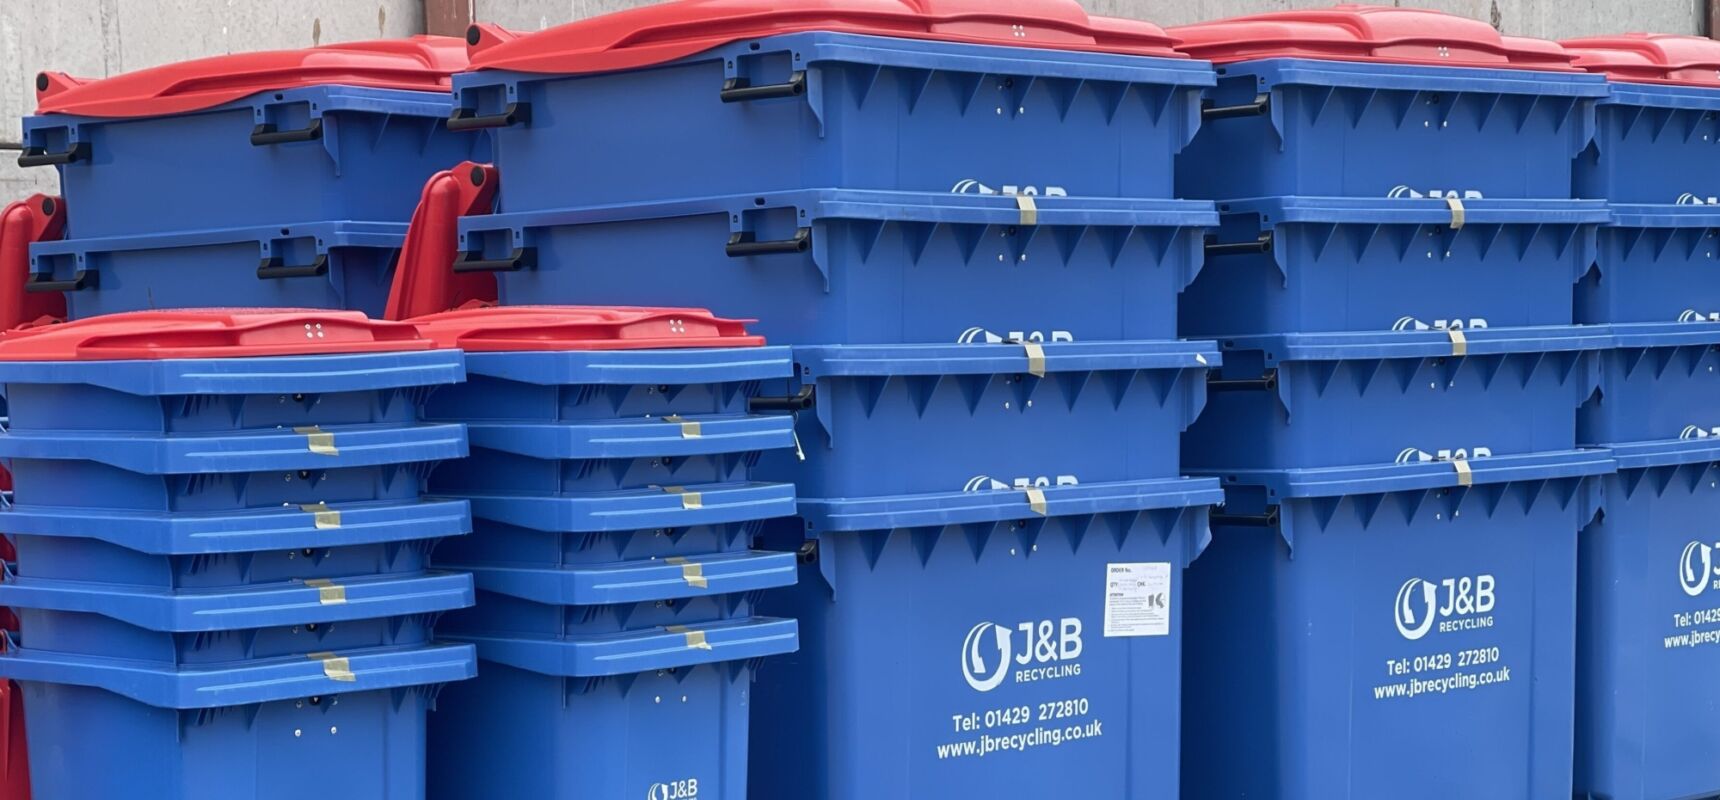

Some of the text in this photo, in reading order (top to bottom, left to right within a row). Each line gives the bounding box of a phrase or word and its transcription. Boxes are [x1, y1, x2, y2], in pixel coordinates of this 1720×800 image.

[1439, 575, 1495, 617] J&B
[1439, 616, 1494, 633] RECYCLING
[1674, 612, 1692, 628] Tel:
[1015, 617, 1083, 665] J&B
[1015, 664, 1082, 683] RECYCLING
[1386, 647, 1500, 676] Tel: 01429 272810
[1374, 666, 1510, 699] www.jbrecycling.co.uk
[952, 698, 1089, 732] Tel: 01429 272810
[937, 719, 1103, 759] www.jbrecycling.co.uk
[669, 778, 698, 799] J&B
